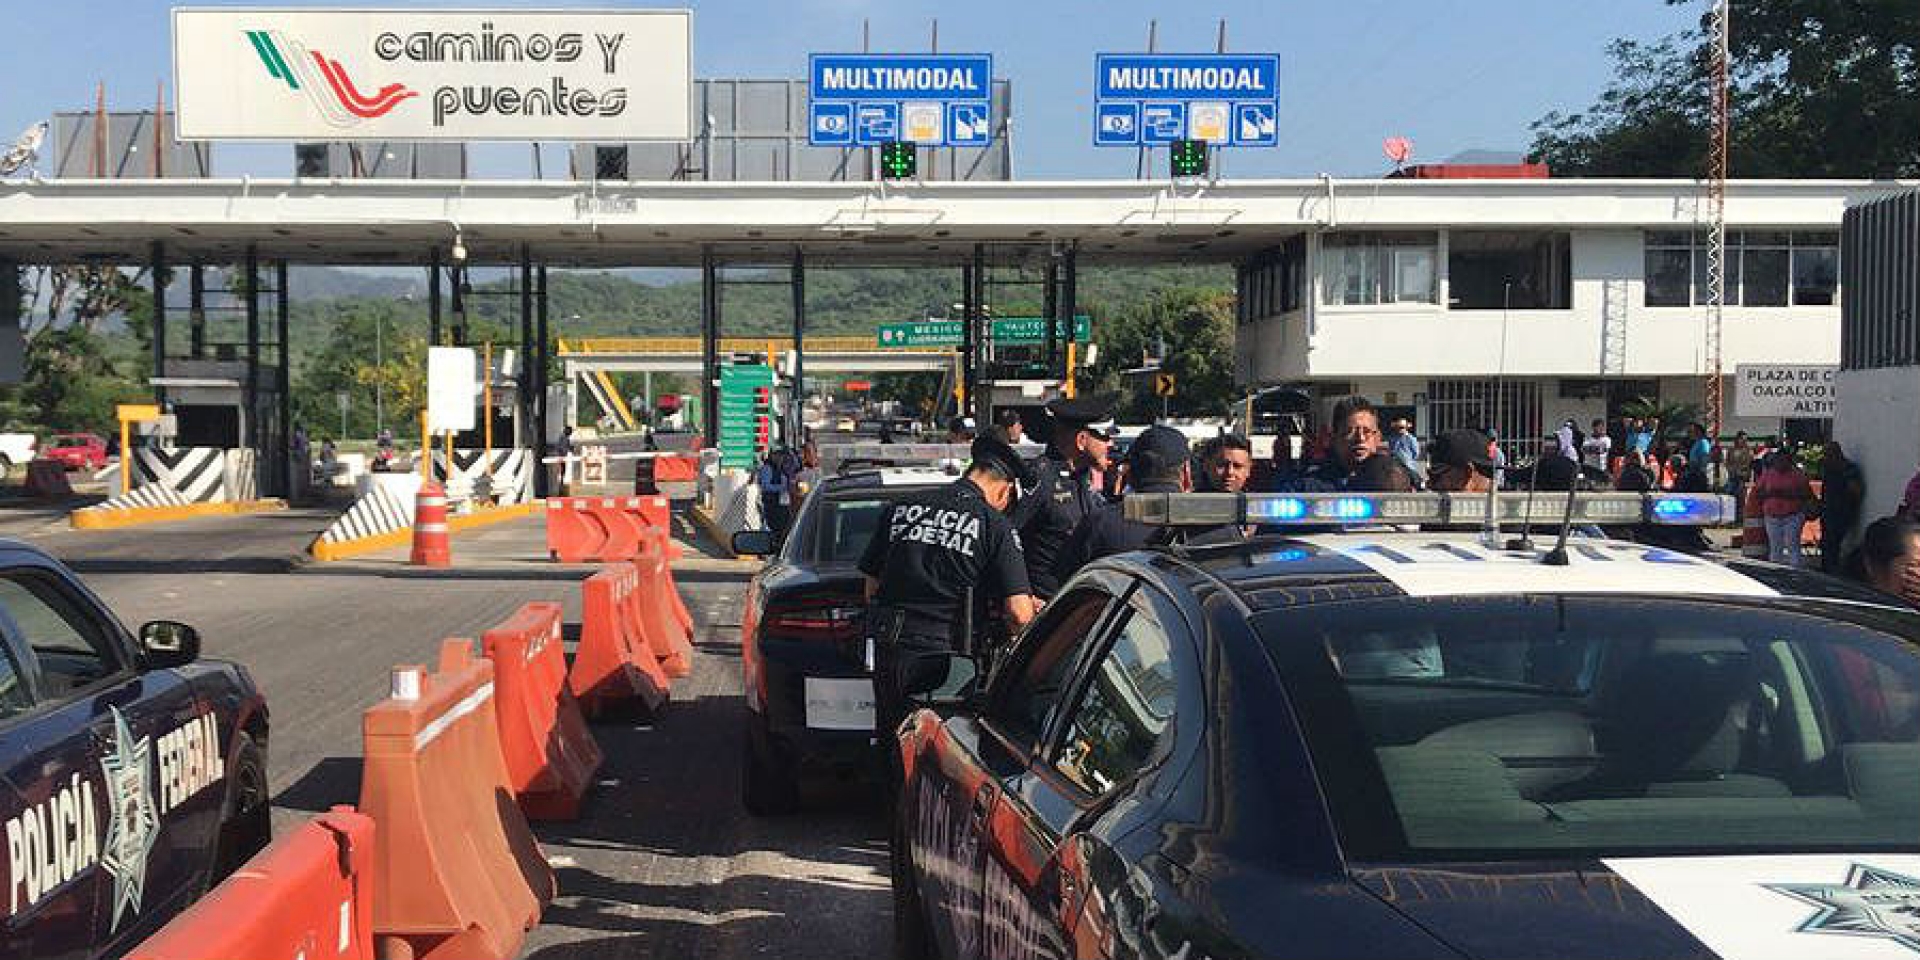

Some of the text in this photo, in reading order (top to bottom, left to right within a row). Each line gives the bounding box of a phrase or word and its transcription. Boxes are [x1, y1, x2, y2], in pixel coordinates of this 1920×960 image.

[375, 22, 583, 62] caminos
[823, 67, 978, 90] MULTIMODAL
[1109, 67, 1265, 90] MULTIMODAL
[433, 77, 628, 126] puentes
[1747, 370, 1795, 381] PLAZA
[1798, 370, 1819, 381] DE
[1753, 386, 1827, 397] OACALCO
[6, 711, 225, 915] POLICÍA FEDERAL
